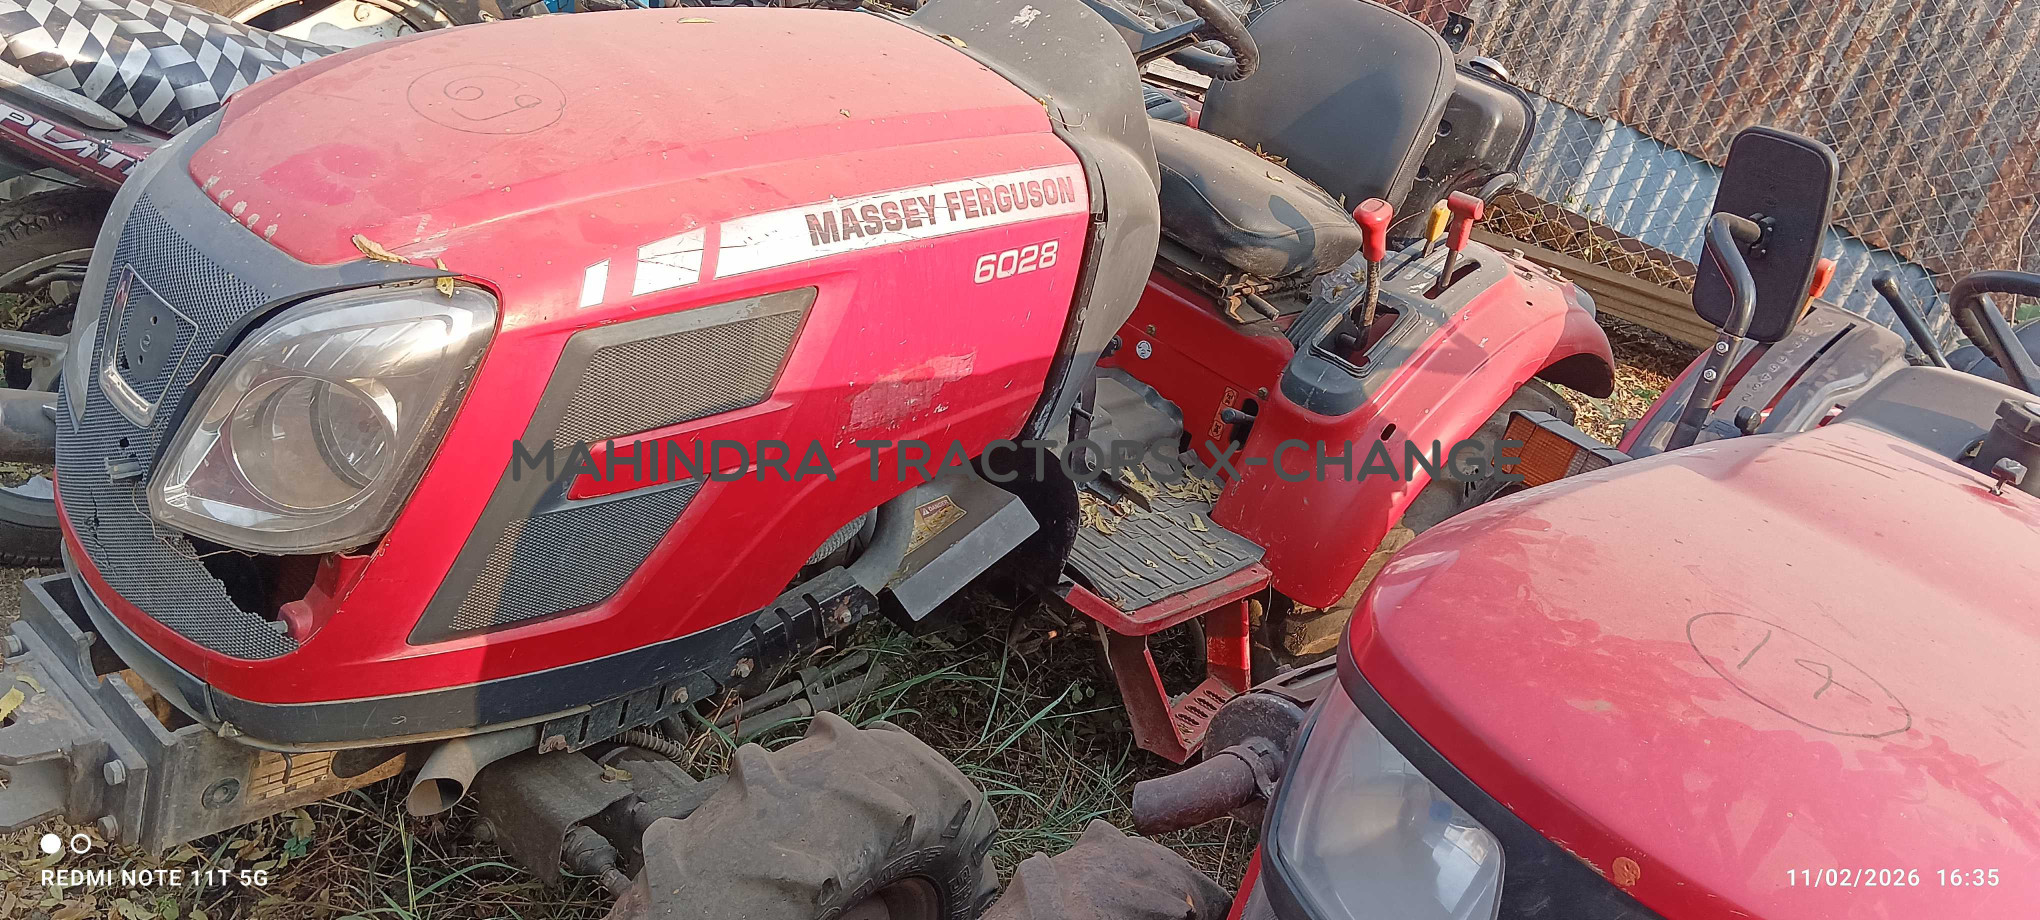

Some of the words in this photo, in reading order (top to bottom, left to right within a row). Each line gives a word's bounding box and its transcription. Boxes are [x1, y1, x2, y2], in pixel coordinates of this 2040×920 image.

[804, 194, 937, 247] MASSEY
[943, 176, 1076, 222] FERGUSON
[973, 240, 1060, 285] 6028
[927, 499, 949, 512] DANGER
